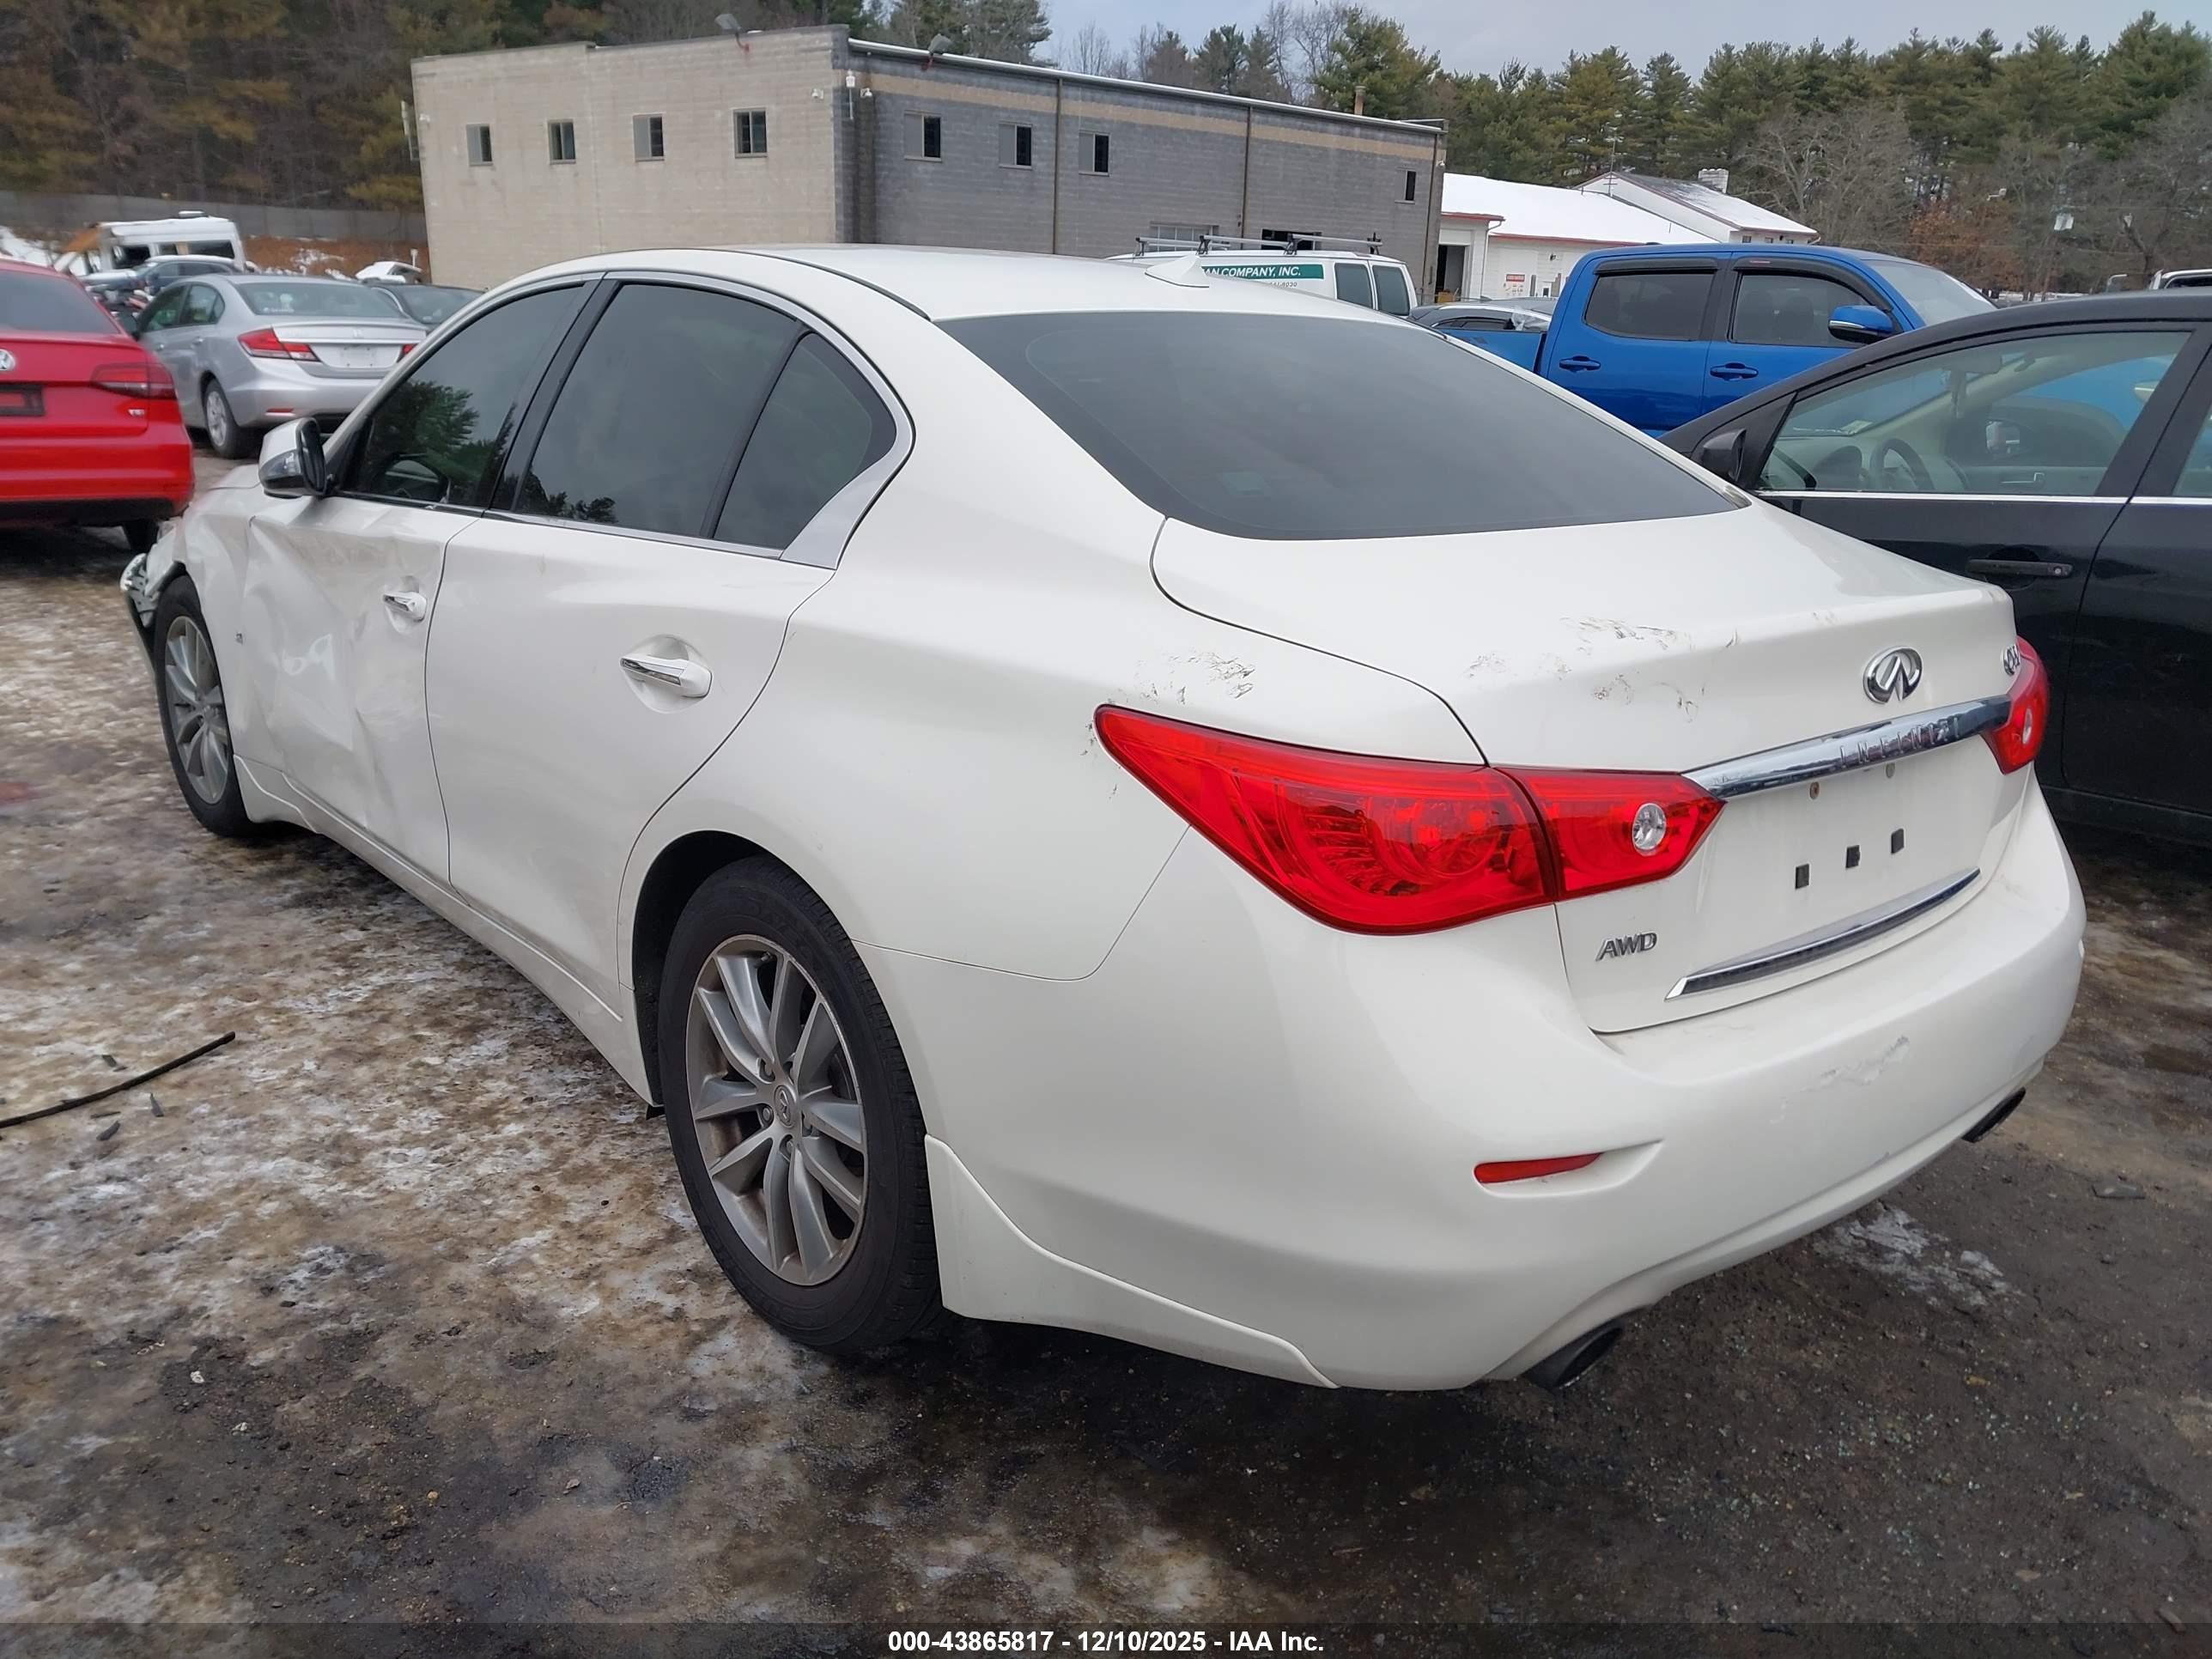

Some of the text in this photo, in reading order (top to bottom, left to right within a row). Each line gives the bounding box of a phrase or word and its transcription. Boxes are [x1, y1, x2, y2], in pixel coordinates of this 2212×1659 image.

[1221, 266, 1276, 277] COMPANY,
[1279, 266, 1301, 276] INC.
[1595, 932, 1657, 963] AWD
